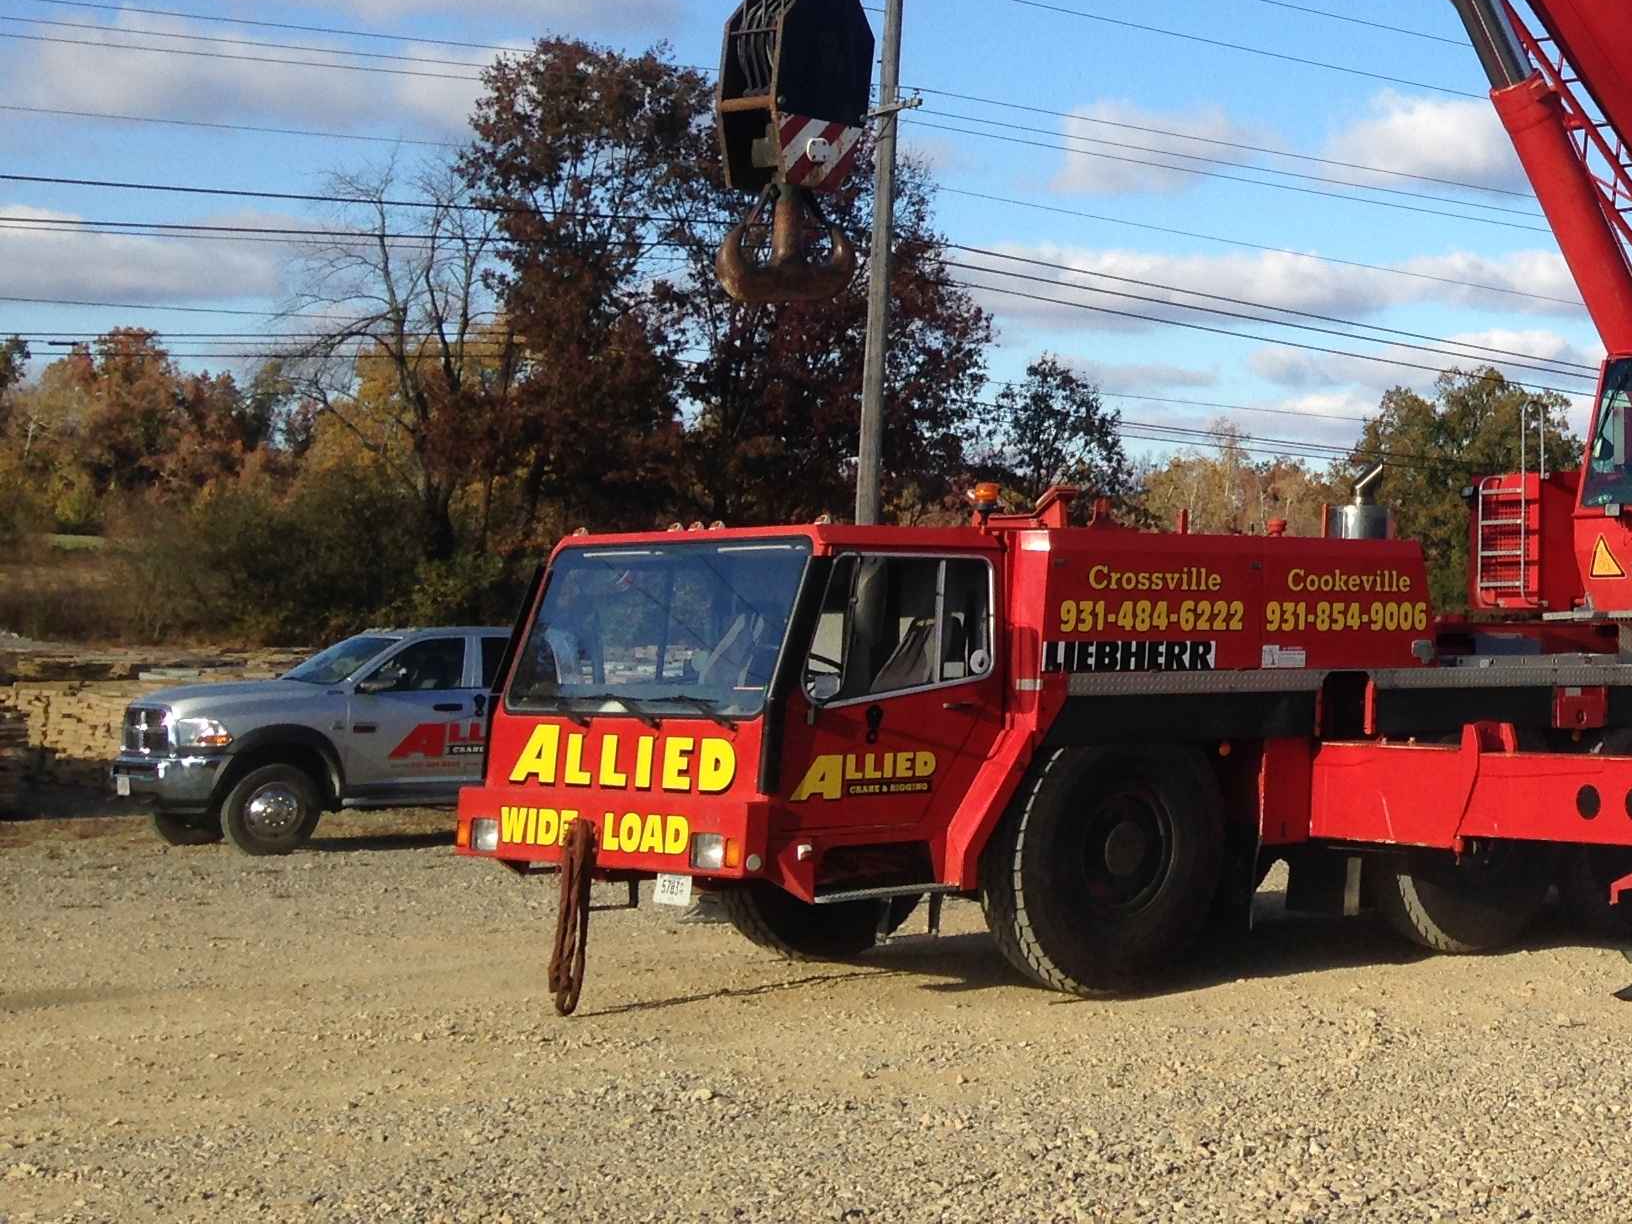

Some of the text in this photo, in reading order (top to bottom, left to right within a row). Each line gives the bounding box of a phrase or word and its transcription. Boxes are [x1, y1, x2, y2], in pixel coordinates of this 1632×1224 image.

[1088, 565, 1222, 591] Crossville
[1287, 568, 1411, 592] Cookeville
[1060, 600, 1244, 632] 931-484-6222
[1265, 601, 1427, 632] 931-854-9006
[1044, 641, 1215, 671] LIEBHERR
[508, 723, 736, 792] ALLIED
[789, 751, 937, 801] ALLIED
[849, 784, 880, 794] CRANE
[889, 782, 929, 793] RIGGING
[602, 812, 690, 855] LOAD
